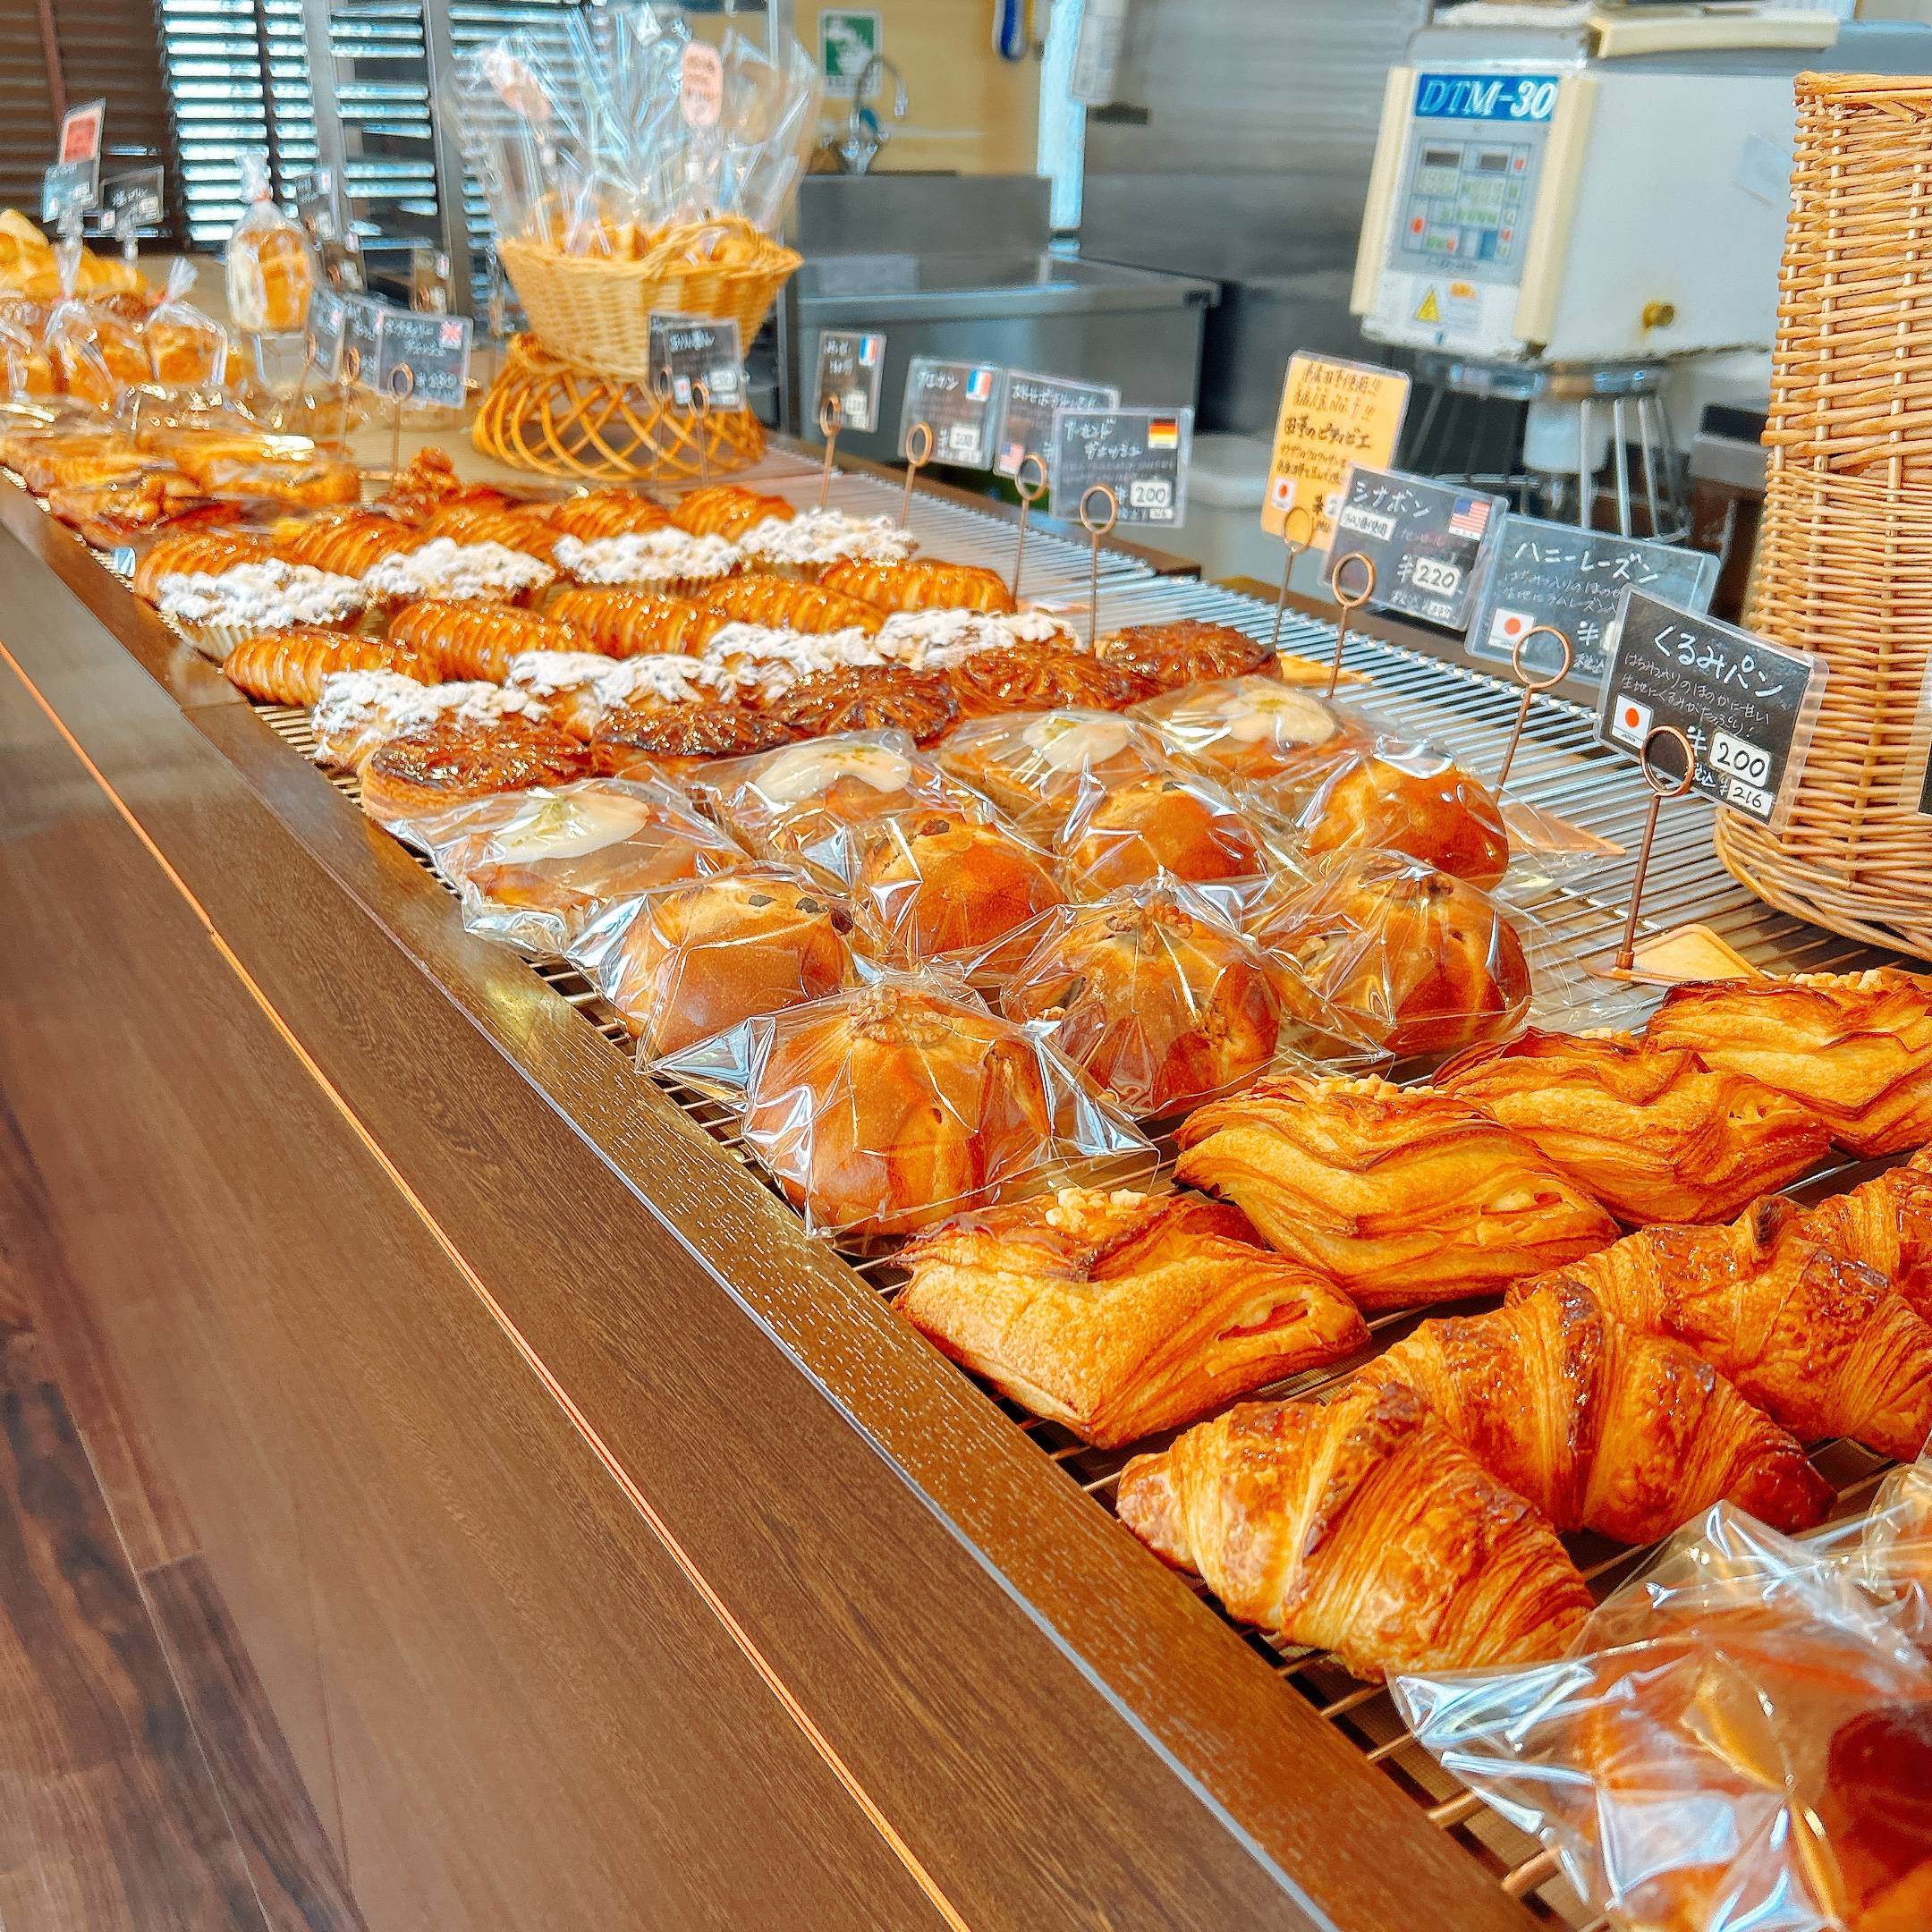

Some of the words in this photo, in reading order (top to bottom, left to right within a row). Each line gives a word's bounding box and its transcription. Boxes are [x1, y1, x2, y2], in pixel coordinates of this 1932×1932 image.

[1419, 80, 1556, 119] DTM-30
[1352, 480, 1431, 518] シナボン
[1514, 541, 1659, 583] ハニーレーズン
[1655, 625, 1783, 698] くるみパン
